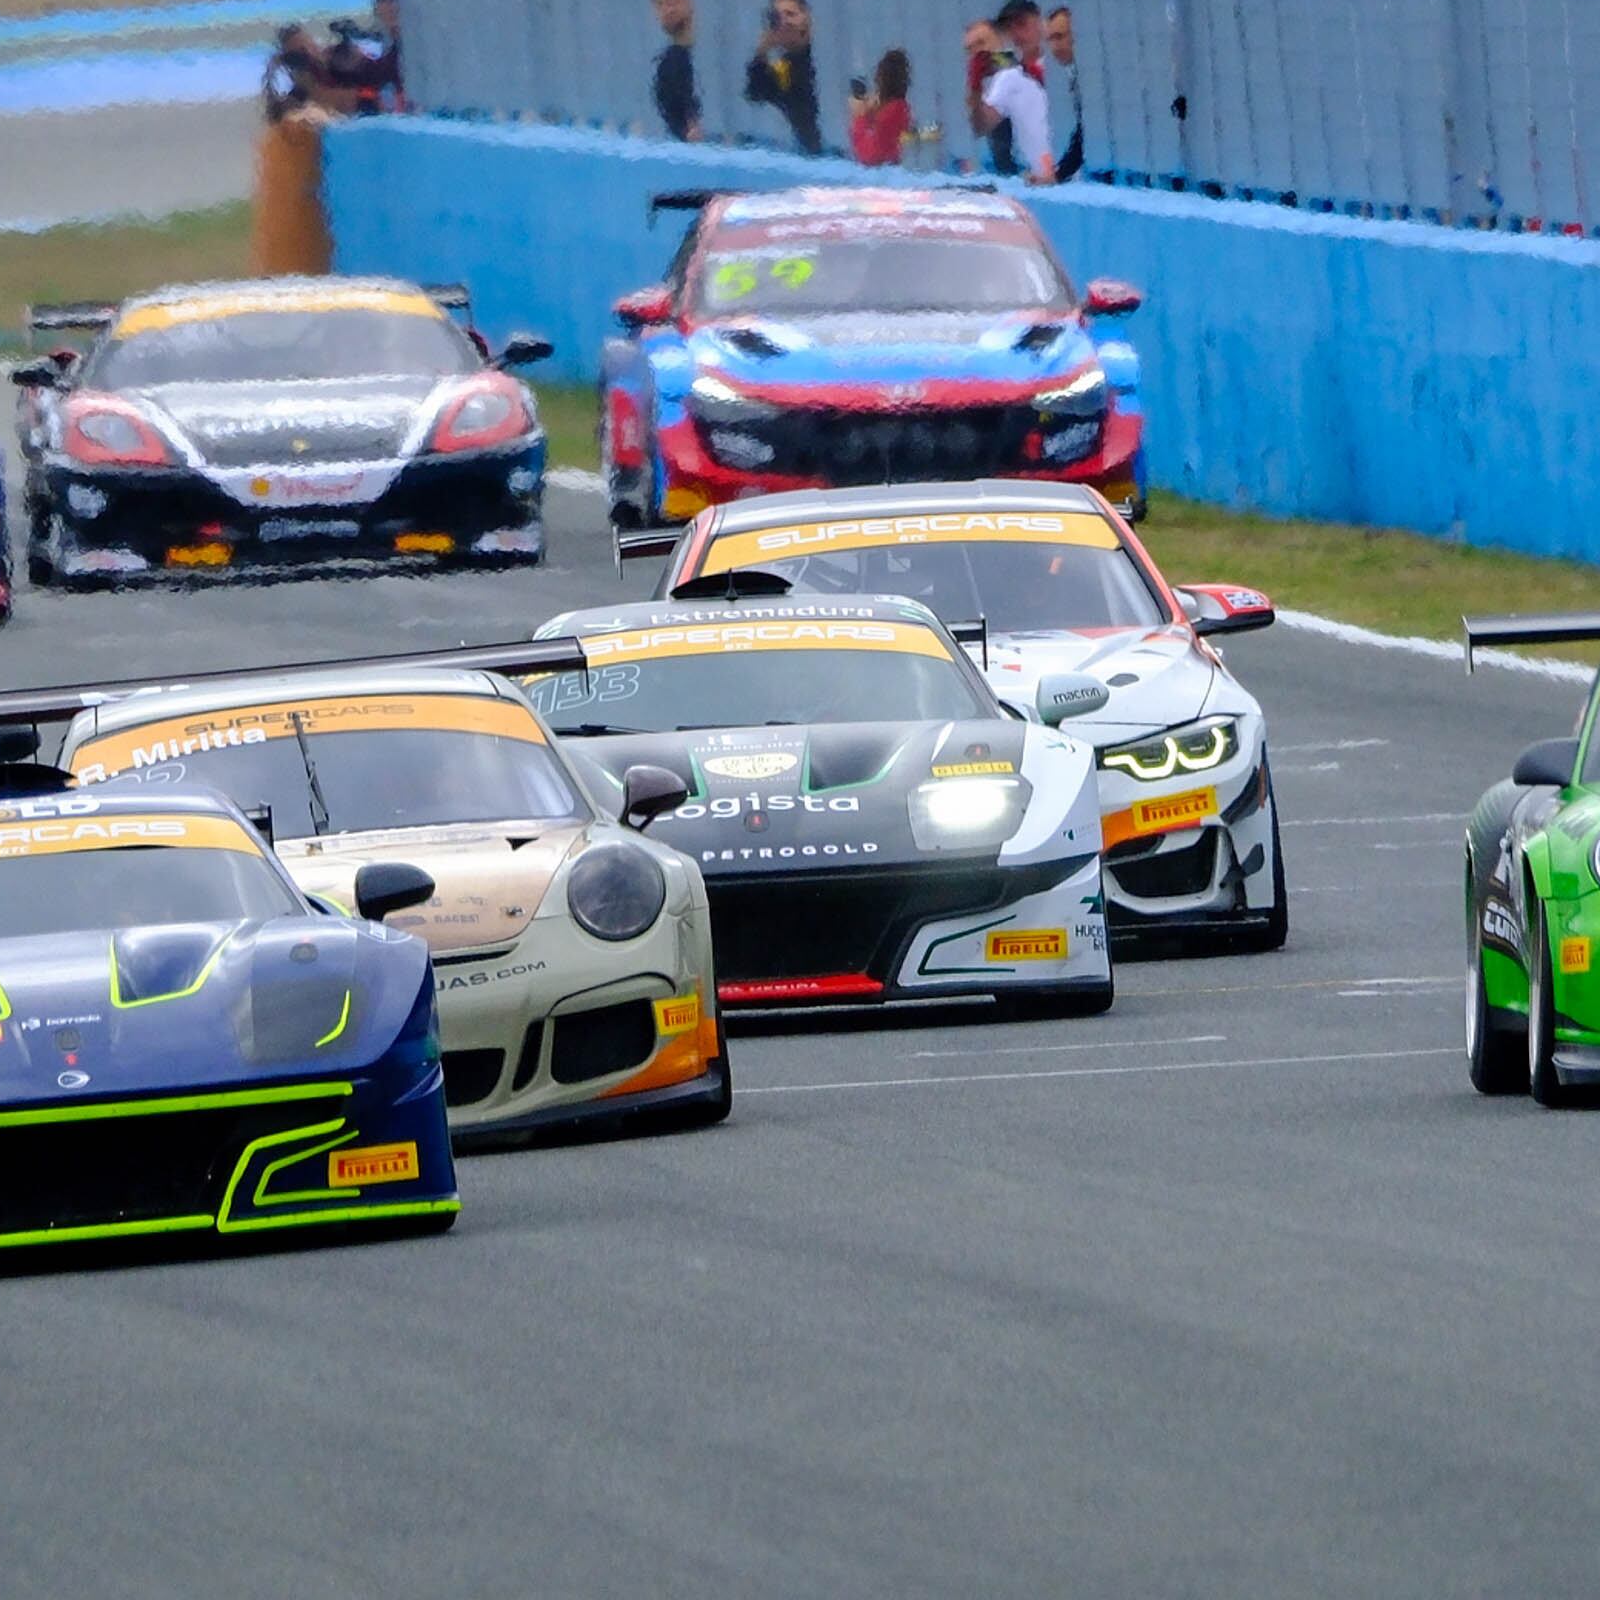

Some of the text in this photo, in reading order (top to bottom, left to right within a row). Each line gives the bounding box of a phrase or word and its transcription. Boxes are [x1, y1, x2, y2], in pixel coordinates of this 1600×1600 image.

[757, 514, 1064, 550] SUPERCARS
[584, 623, 896, 654] SUPERCARS
[529, 663, 642, 715] 133
[1053, 686, 1101, 705] macron
[184, 704, 415, 736] SUPERCARS
[78, 762, 120, 787] R.
[131, 726, 268, 768] Miritta
[1141, 793, 1208, 822] PIRELLI
[702, 843, 878, 862] PETROGOLD
[992, 935, 1061, 955] PIRELLI
[338, 1151, 409, 1179] PIRELLI
